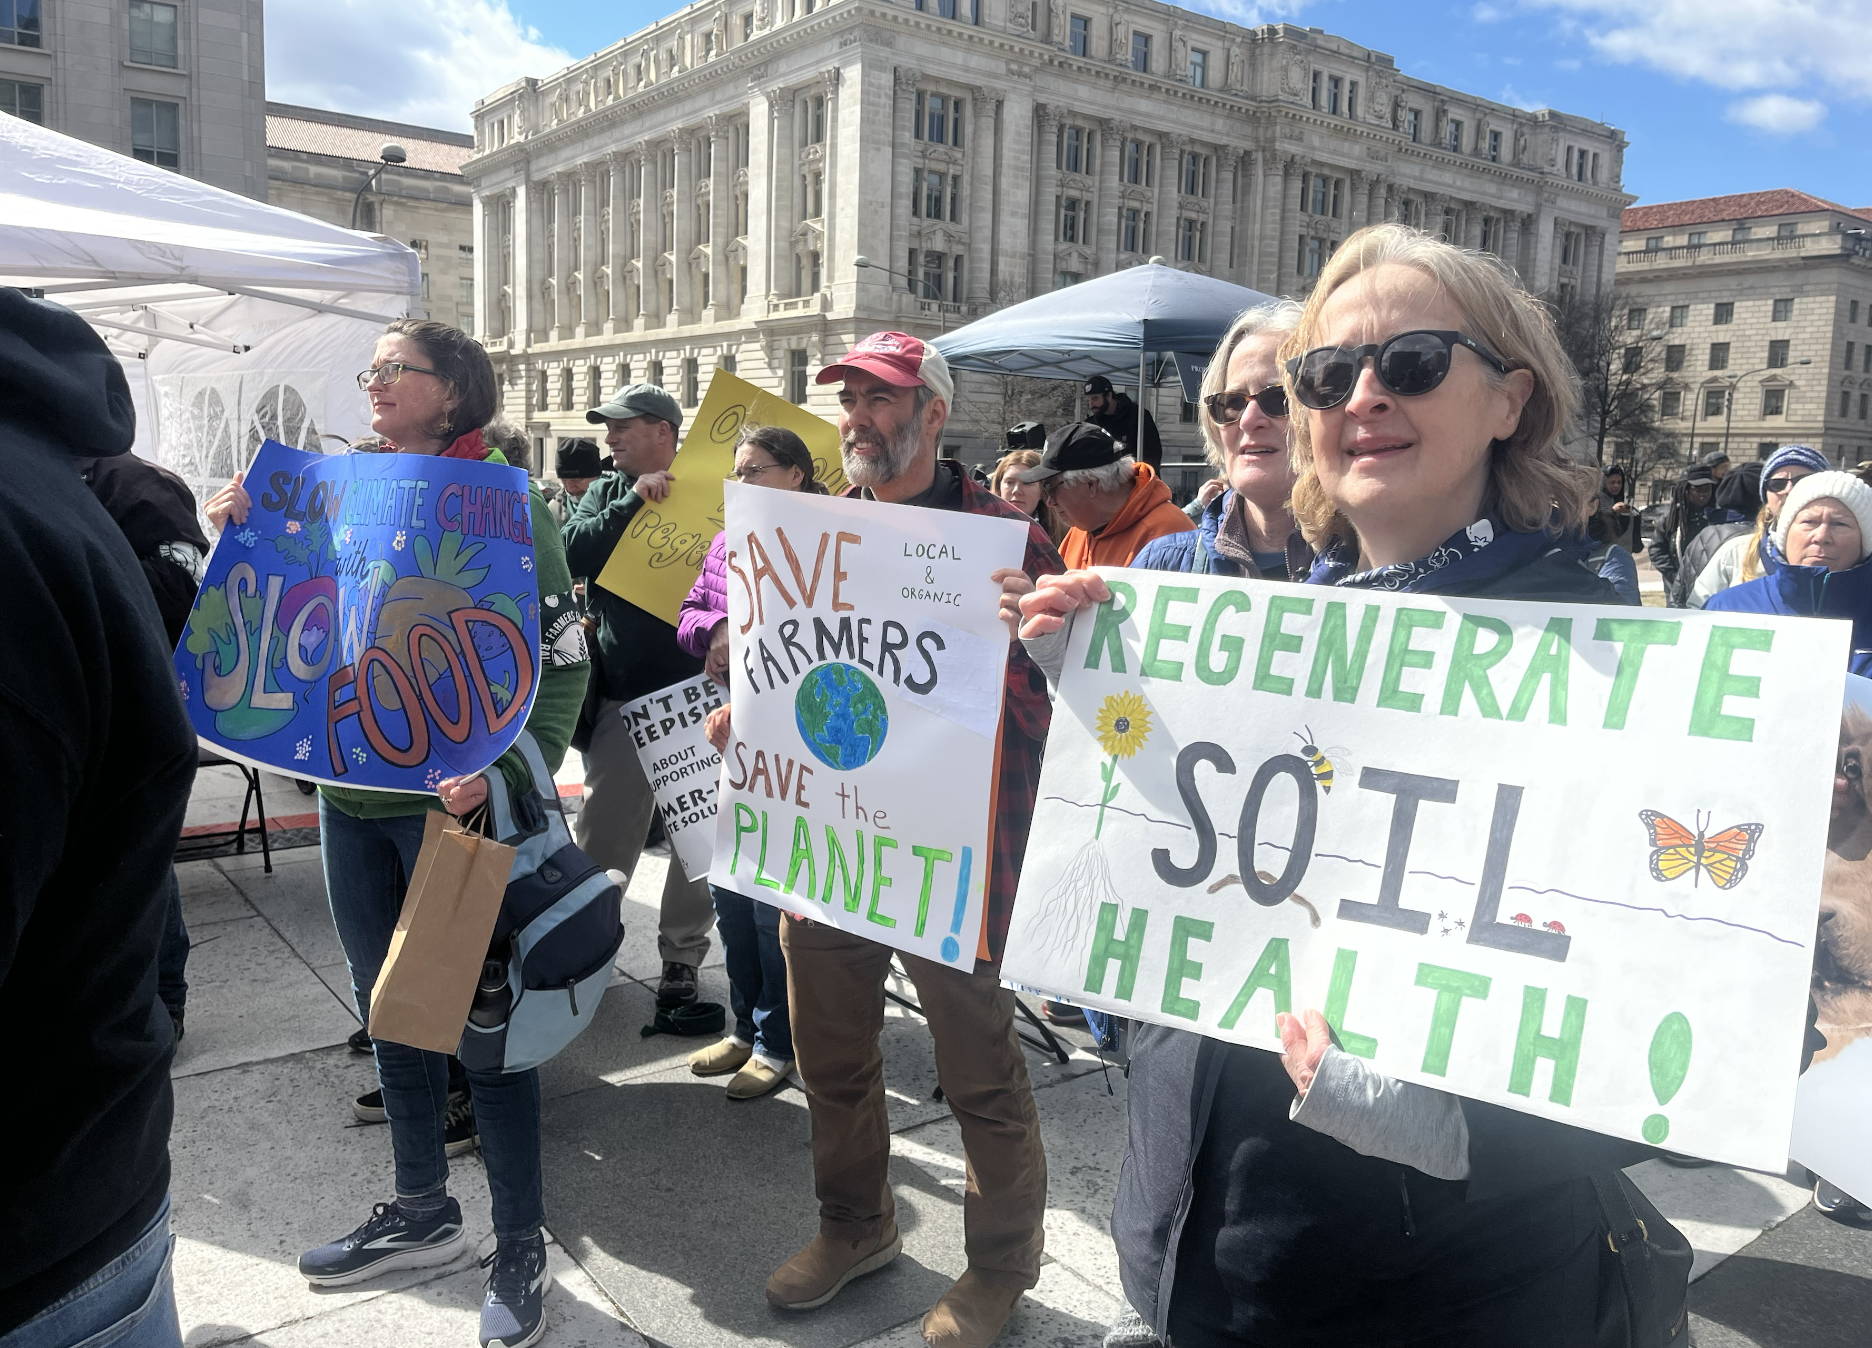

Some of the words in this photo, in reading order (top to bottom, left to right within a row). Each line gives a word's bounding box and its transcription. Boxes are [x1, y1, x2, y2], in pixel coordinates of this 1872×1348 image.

[262, 471, 347, 523] SLOW
[345, 478, 430, 530] CLIMATE
[435, 482, 533, 547] CHANGE
[334, 538, 370, 581] with
[727, 526, 861, 635] SAVE
[903, 542, 962, 561] LOCAL
[924, 565, 934, 585] &
[545, 610, 576, 640] FARMERS
[901, 586, 962, 607] ORGANIC
[201, 562, 380, 711] SLOW
[743, 616, 946, 696] FARMERS
[1083, 579, 1776, 742] REGENERATE
[327, 607, 534, 777] FOOD
[683, 679, 719, 705] BE
[652, 745, 696, 775] ABOUT
[729, 742, 814, 810] SAVE
[835, 782, 891, 830] the
[680, 803, 718, 828] SOLU
[1150, 740, 1572, 963] SOIL
[730, 802, 973, 964] PLANET!
